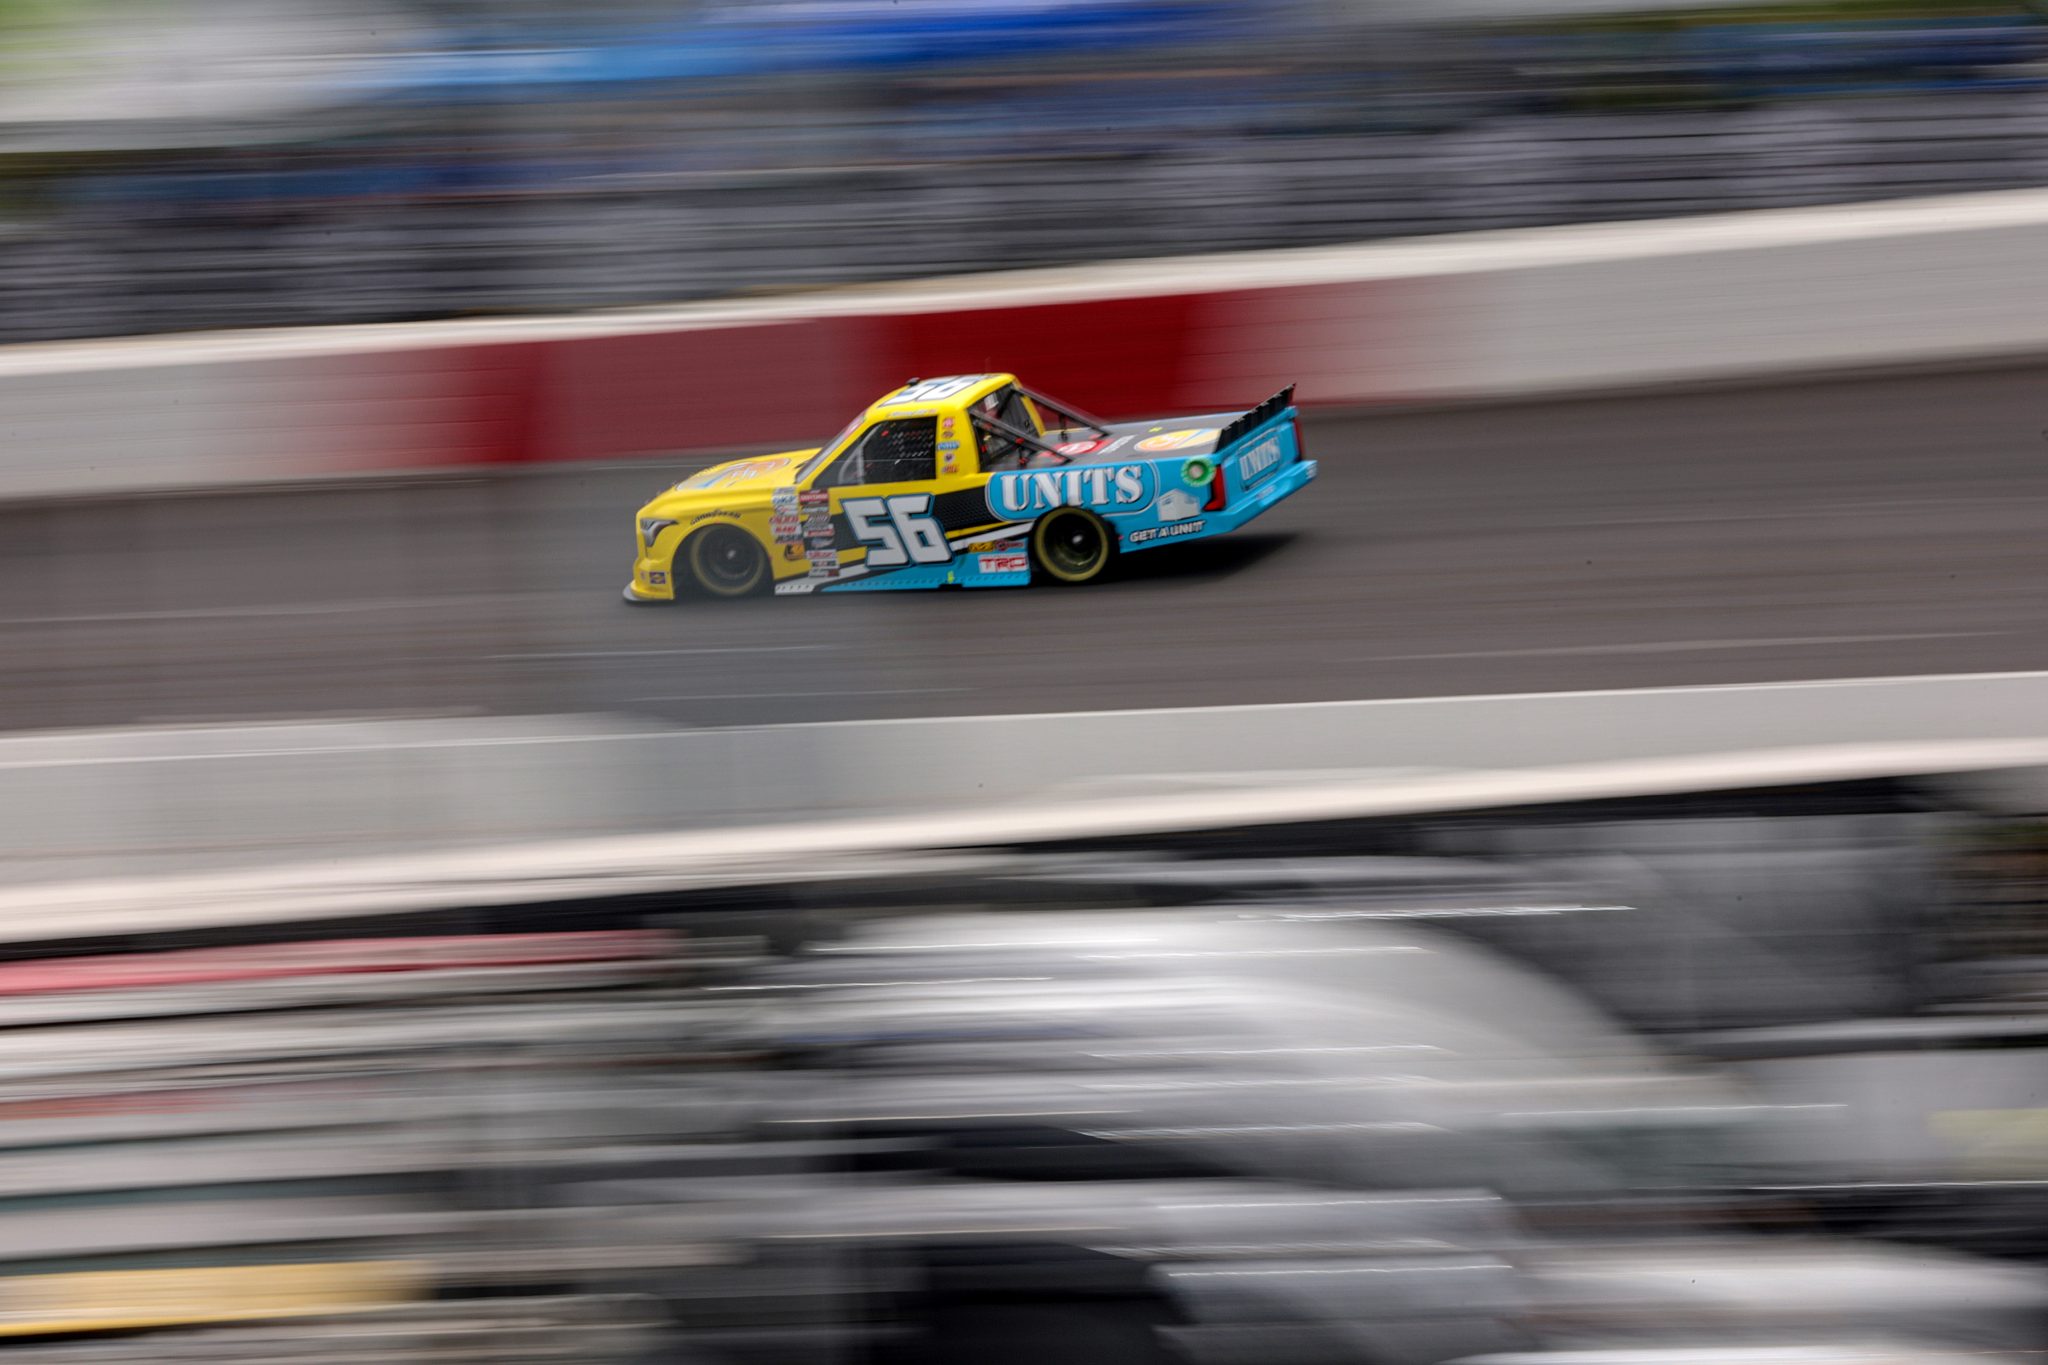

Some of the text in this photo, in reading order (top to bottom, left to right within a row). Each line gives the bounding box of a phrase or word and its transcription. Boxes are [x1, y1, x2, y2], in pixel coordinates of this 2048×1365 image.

[1240, 436, 1281, 482] UNITS
[1000, 465, 1144, 512] UNITS
[842, 495, 952, 567] 56
[1130, 520, 1206, 544] GET A UNIT
[979, 555, 1026, 574] TRD
